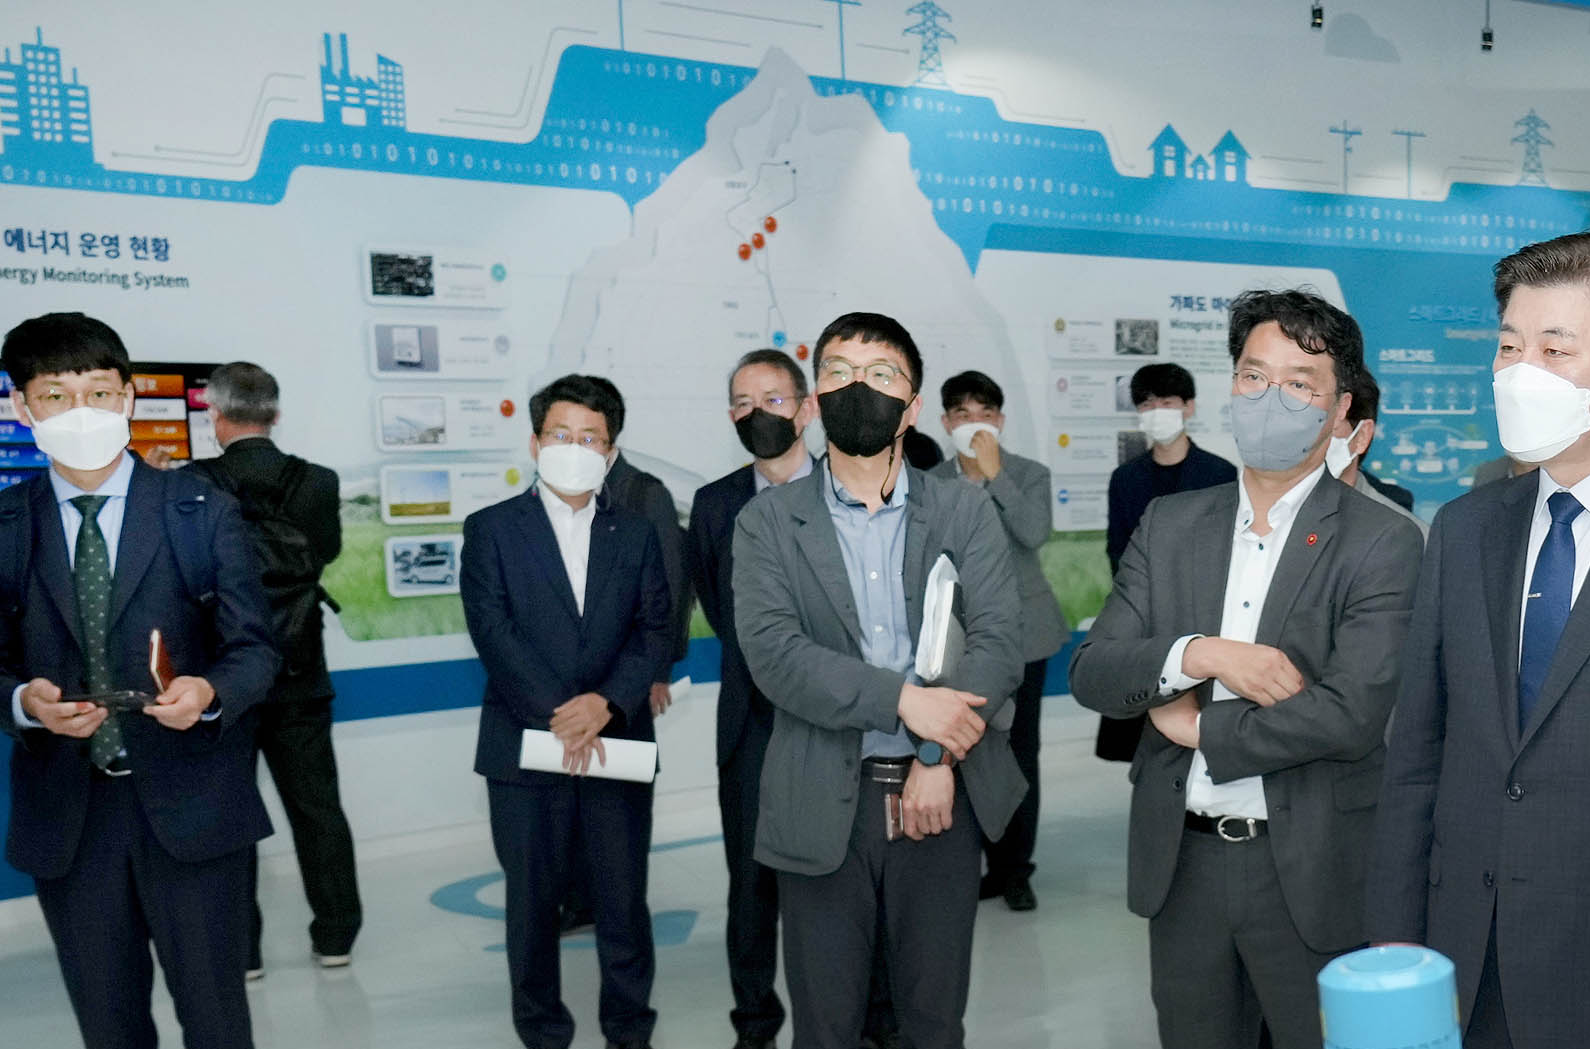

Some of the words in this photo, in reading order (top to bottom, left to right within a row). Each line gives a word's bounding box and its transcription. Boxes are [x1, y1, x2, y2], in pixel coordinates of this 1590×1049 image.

[4, 228, 70, 256] 에너지
[79, 232, 121, 260] 운영
[129, 235, 171, 262] 현황
[43, 266, 131, 290] Monitoring
[134, 271, 190, 291] System
